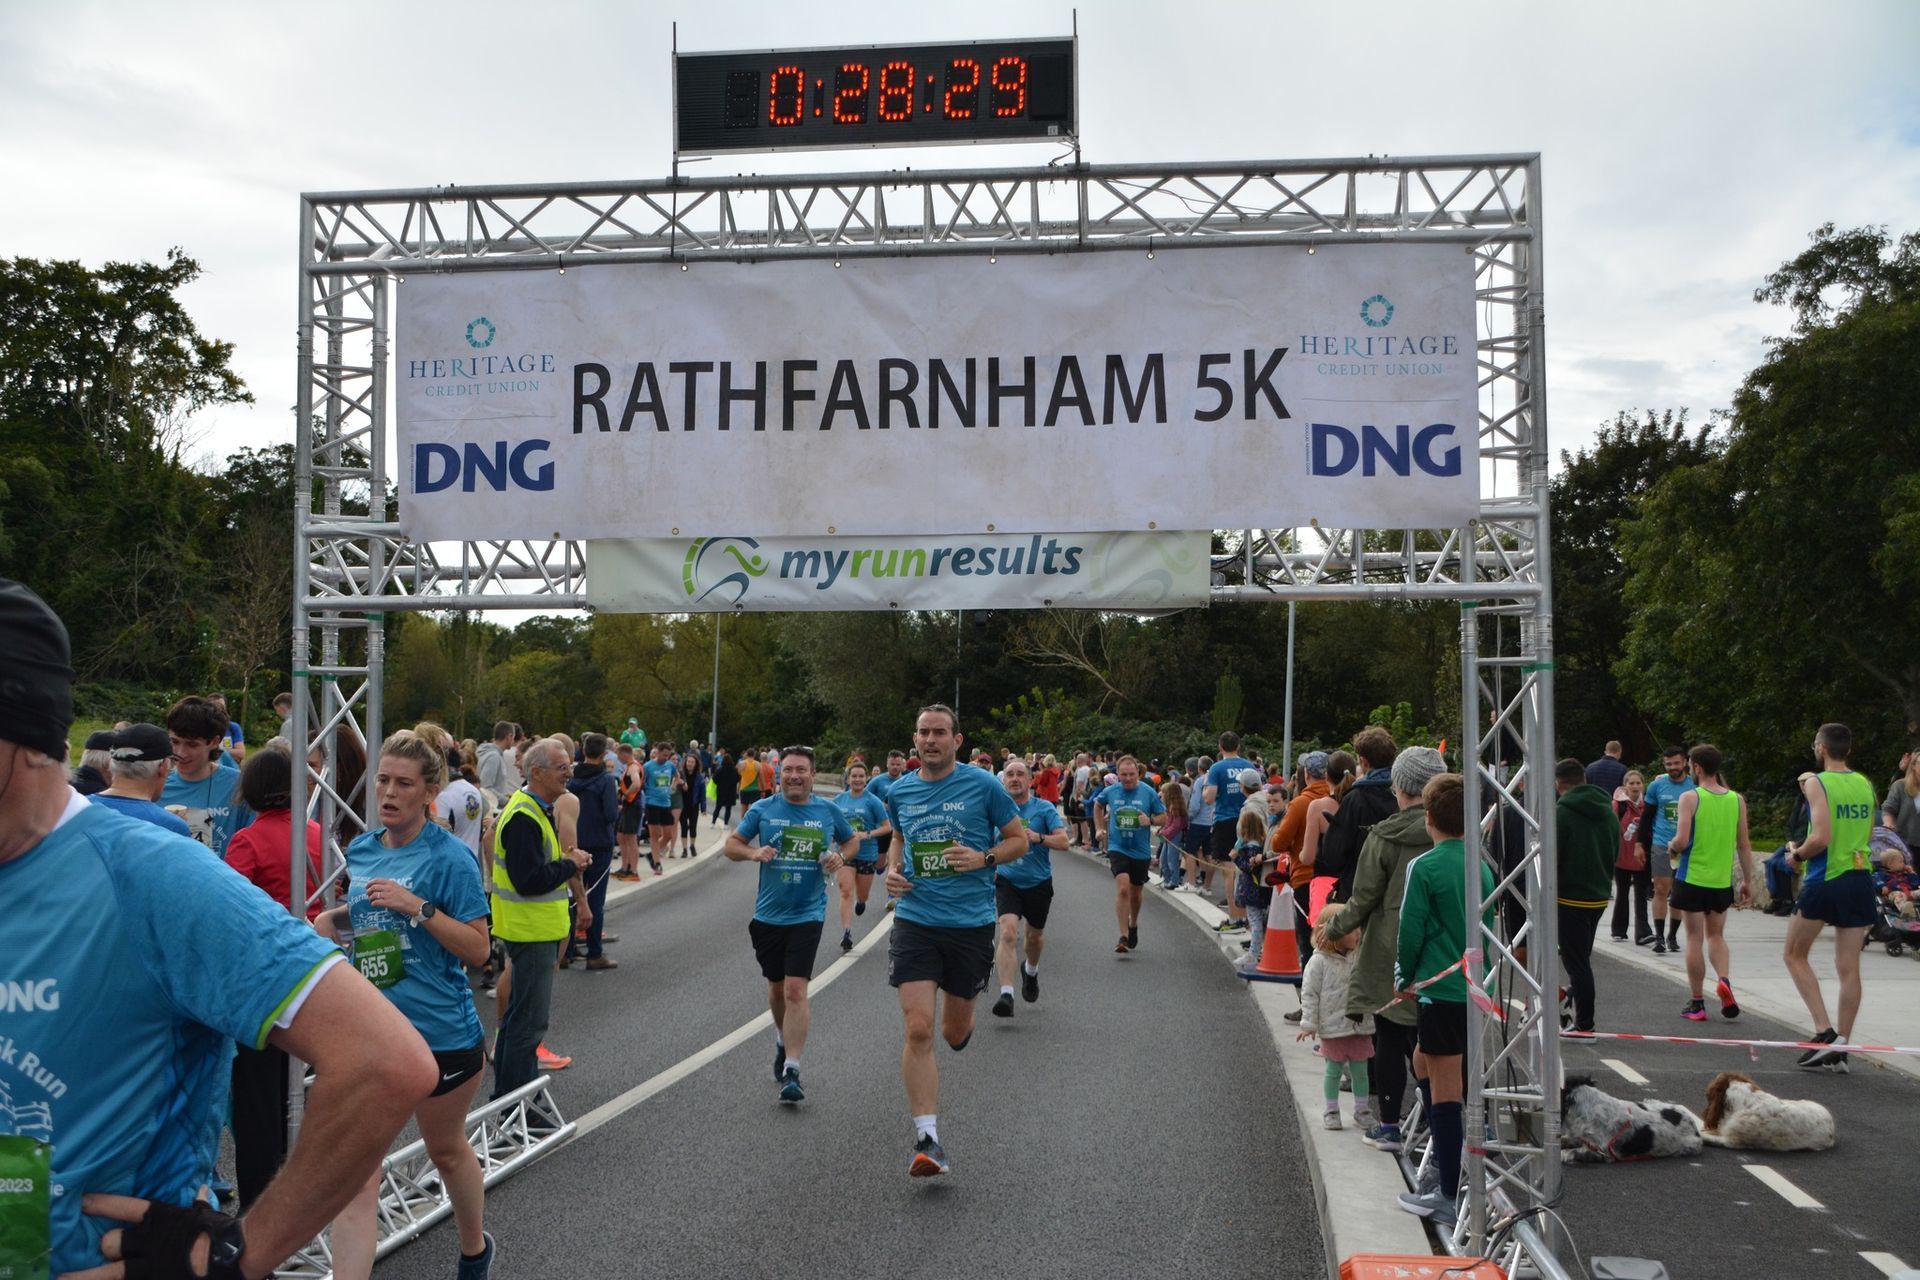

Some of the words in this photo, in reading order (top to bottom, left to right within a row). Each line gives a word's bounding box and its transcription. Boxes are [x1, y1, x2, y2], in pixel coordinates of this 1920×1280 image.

[770, 56, 1027, 124] 0:28:29
[1299, 335, 1458, 359] HERITAGE
[409, 354, 556, 379] HERITAGE
[1317, 363, 1379, 376] CREDIT
[1385, 363, 1443, 376] UNION
[425, 383, 482, 397] CREDIT
[488, 380, 540, 394] UNION
[573, 354, 1168, 434] RATHFARNHAM
[1193, 348, 1291, 421] 5K
[1311, 423, 1462, 477] DNG
[415, 438, 555, 494] DNG
[780, 535, 1083, 590] myrunresults
[942, 802, 965, 812] DNG
[1836, 804, 1869, 820] MSB
[804, 820, 823, 828] DNG
[791, 840, 814, 854] 754
[922, 855, 949, 871] 624
[361, 955, 388, 978] 655
[18, 1051, 68, 1099] Run
[0, 1178, 34, 1193] 2023
